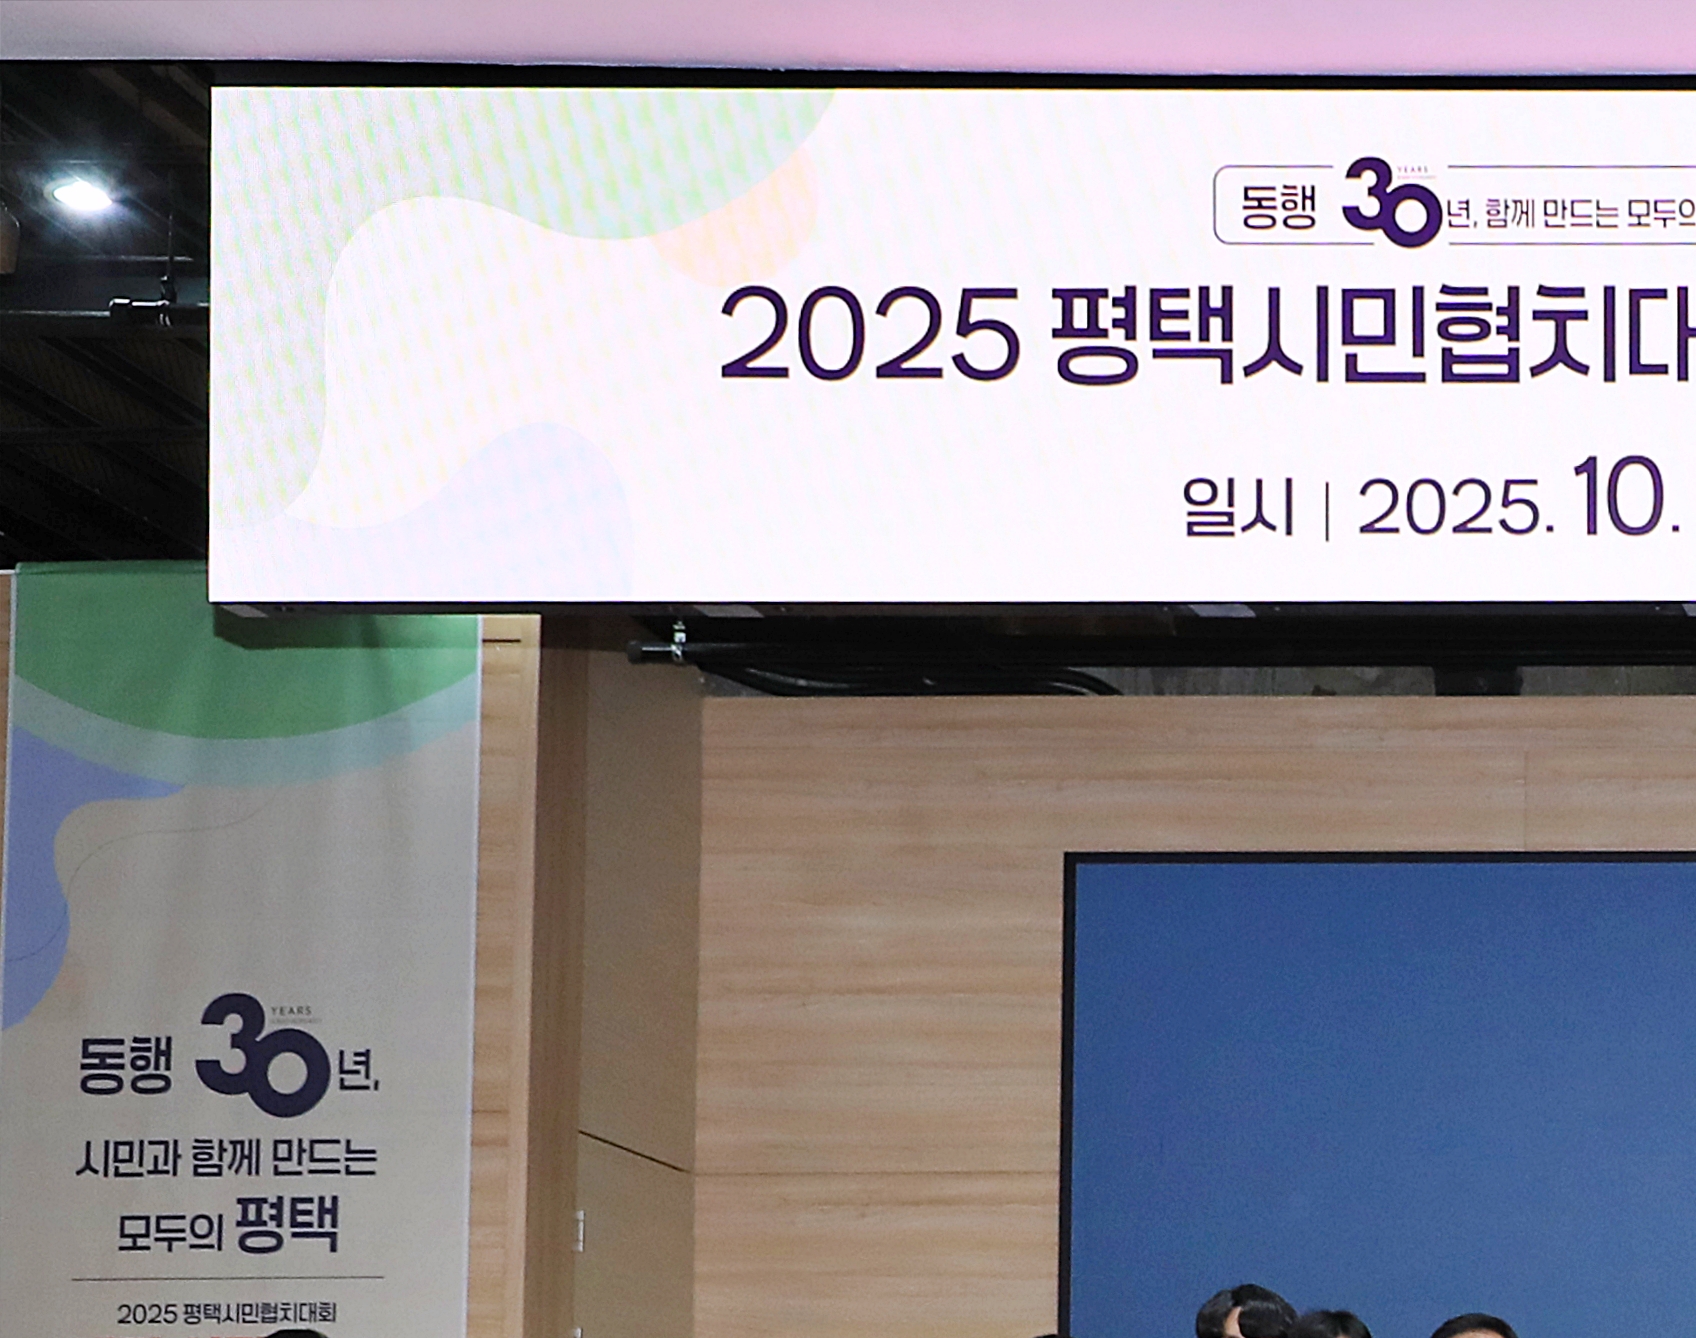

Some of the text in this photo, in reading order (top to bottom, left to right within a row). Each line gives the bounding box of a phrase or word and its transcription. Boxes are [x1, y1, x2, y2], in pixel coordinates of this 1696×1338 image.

[1242, 184, 1316, 230] 동행
[1486, 198, 1536, 229] 함께
[1543, 199, 1619, 228] 만드는
[720, 284, 1021, 383] 2025
[1183, 476, 1296, 538] 일시
[271, 1005, 311, 1016] YEARS
[80, 1035, 173, 1096] 동행
[75, 1138, 378, 1179] 시민과 함께 만드는
[118, 1196, 339, 1254] 모두의 평택
[117, 1302, 337, 1325] 2025 평택시민협치대회
